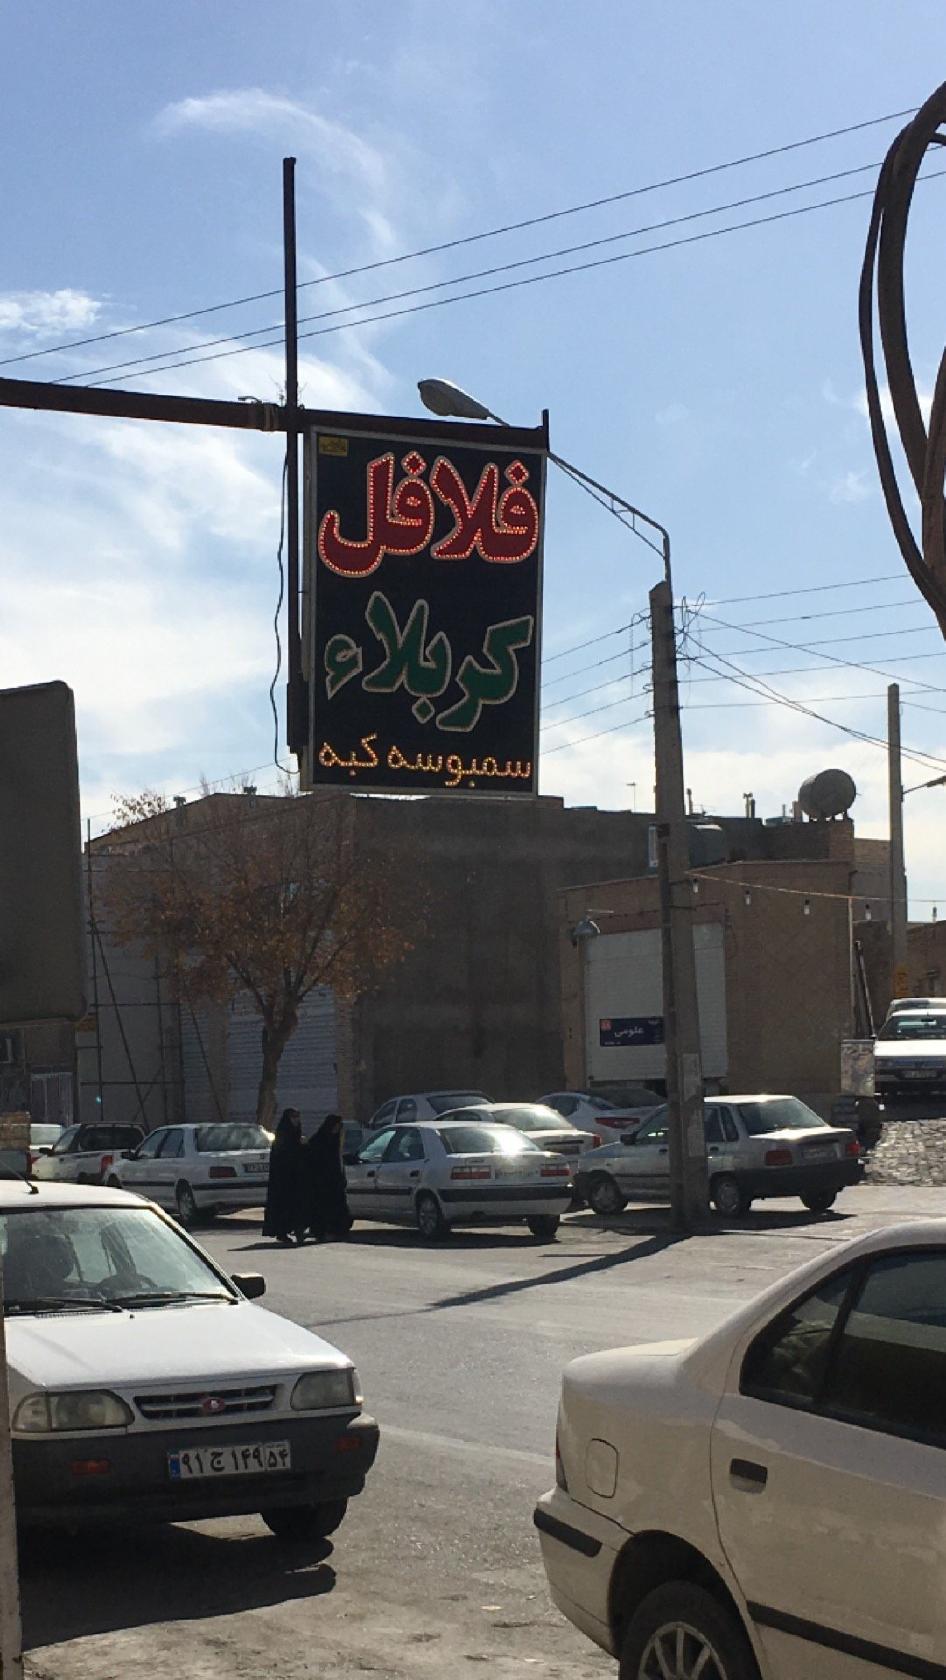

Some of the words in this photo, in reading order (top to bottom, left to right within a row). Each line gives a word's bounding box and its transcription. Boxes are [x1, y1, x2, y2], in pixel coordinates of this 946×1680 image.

[318, 451, 539, 577] فلافل
[318, 732, 378, 776] کبه
[386, 745, 531, 788] سمبوسه
